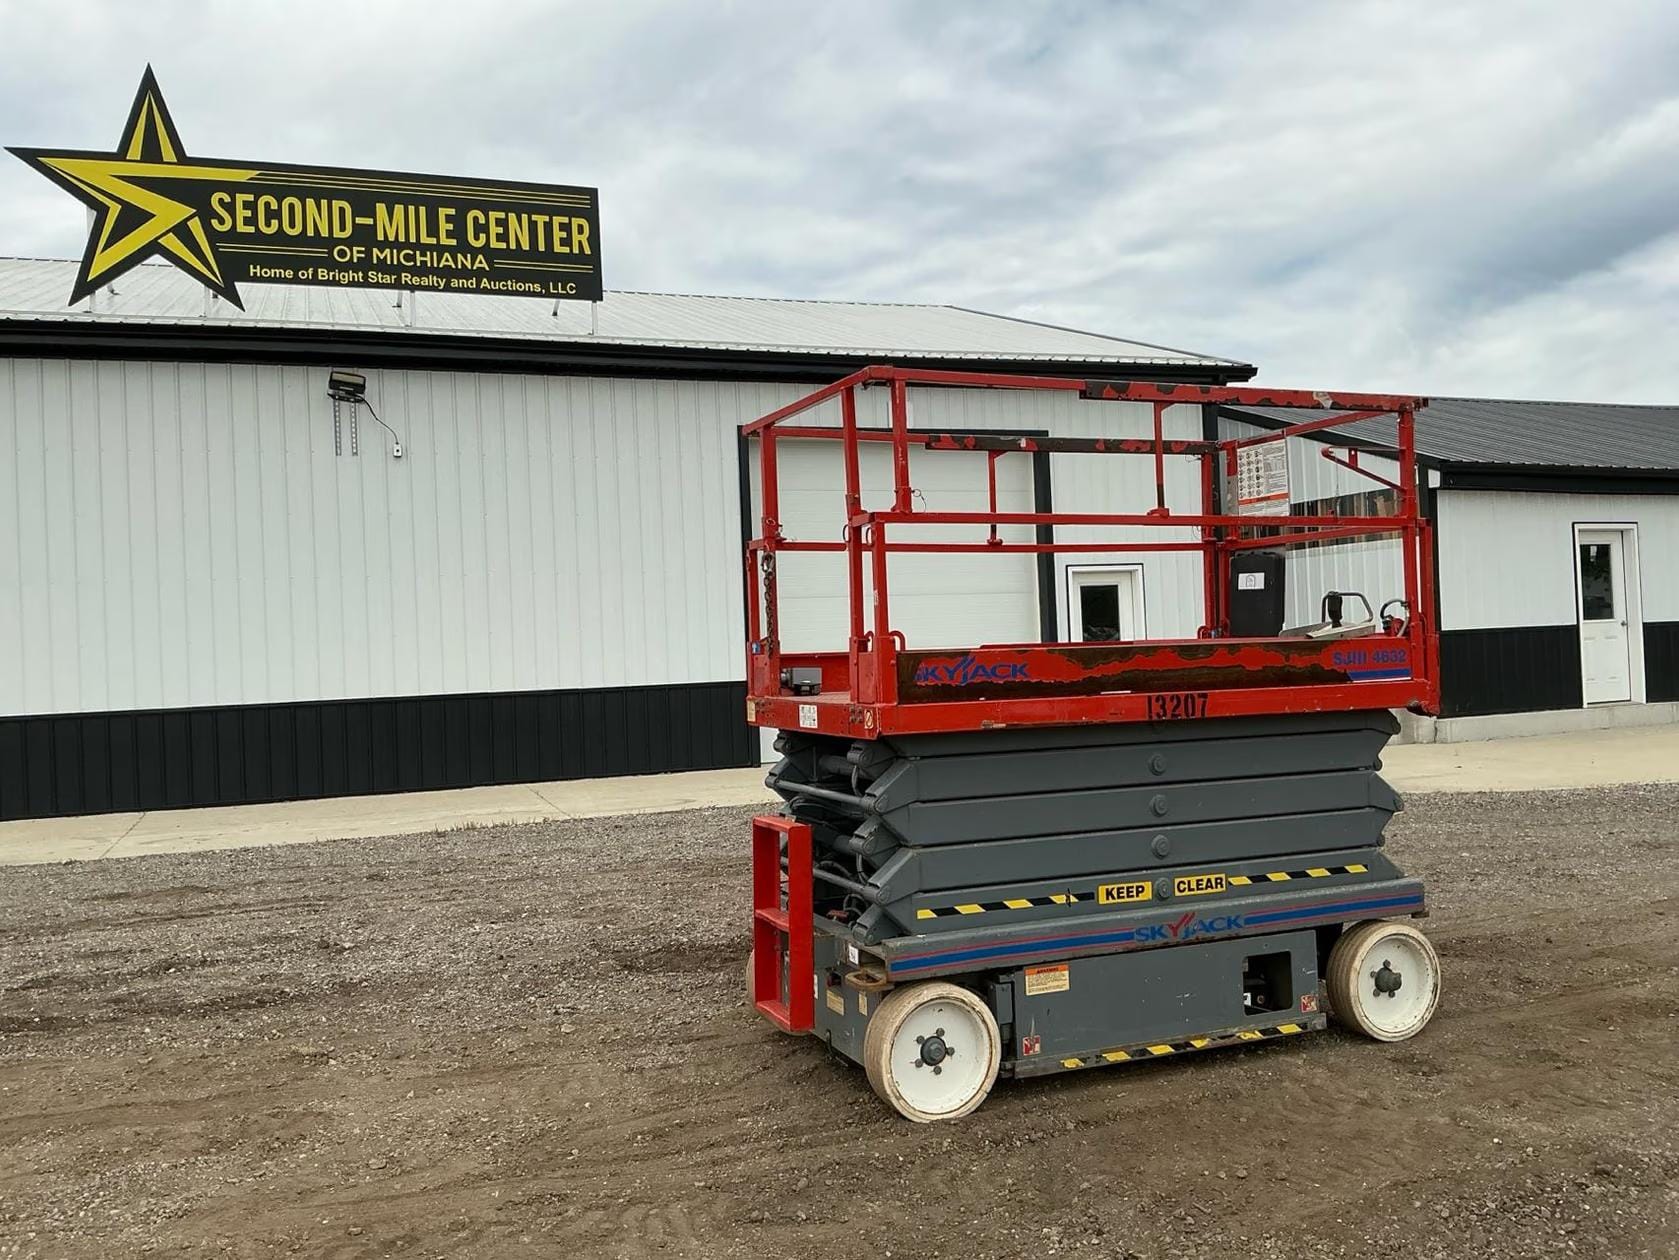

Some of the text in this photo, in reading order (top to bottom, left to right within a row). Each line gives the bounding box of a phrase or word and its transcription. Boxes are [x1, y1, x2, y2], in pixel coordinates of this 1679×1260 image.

[210, 191, 592, 255] SECOND-MILE CENTER
[333, 245, 490, 271] OF MICHIANA
[249, 264, 577, 295] Home of Bright Star Realty and Auctions, LLC
[1147, 692, 1209, 720] 13207
[1105, 876, 1225, 901] KEEP CLEAR
[1134, 911, 1243, 943] SKYJACK
